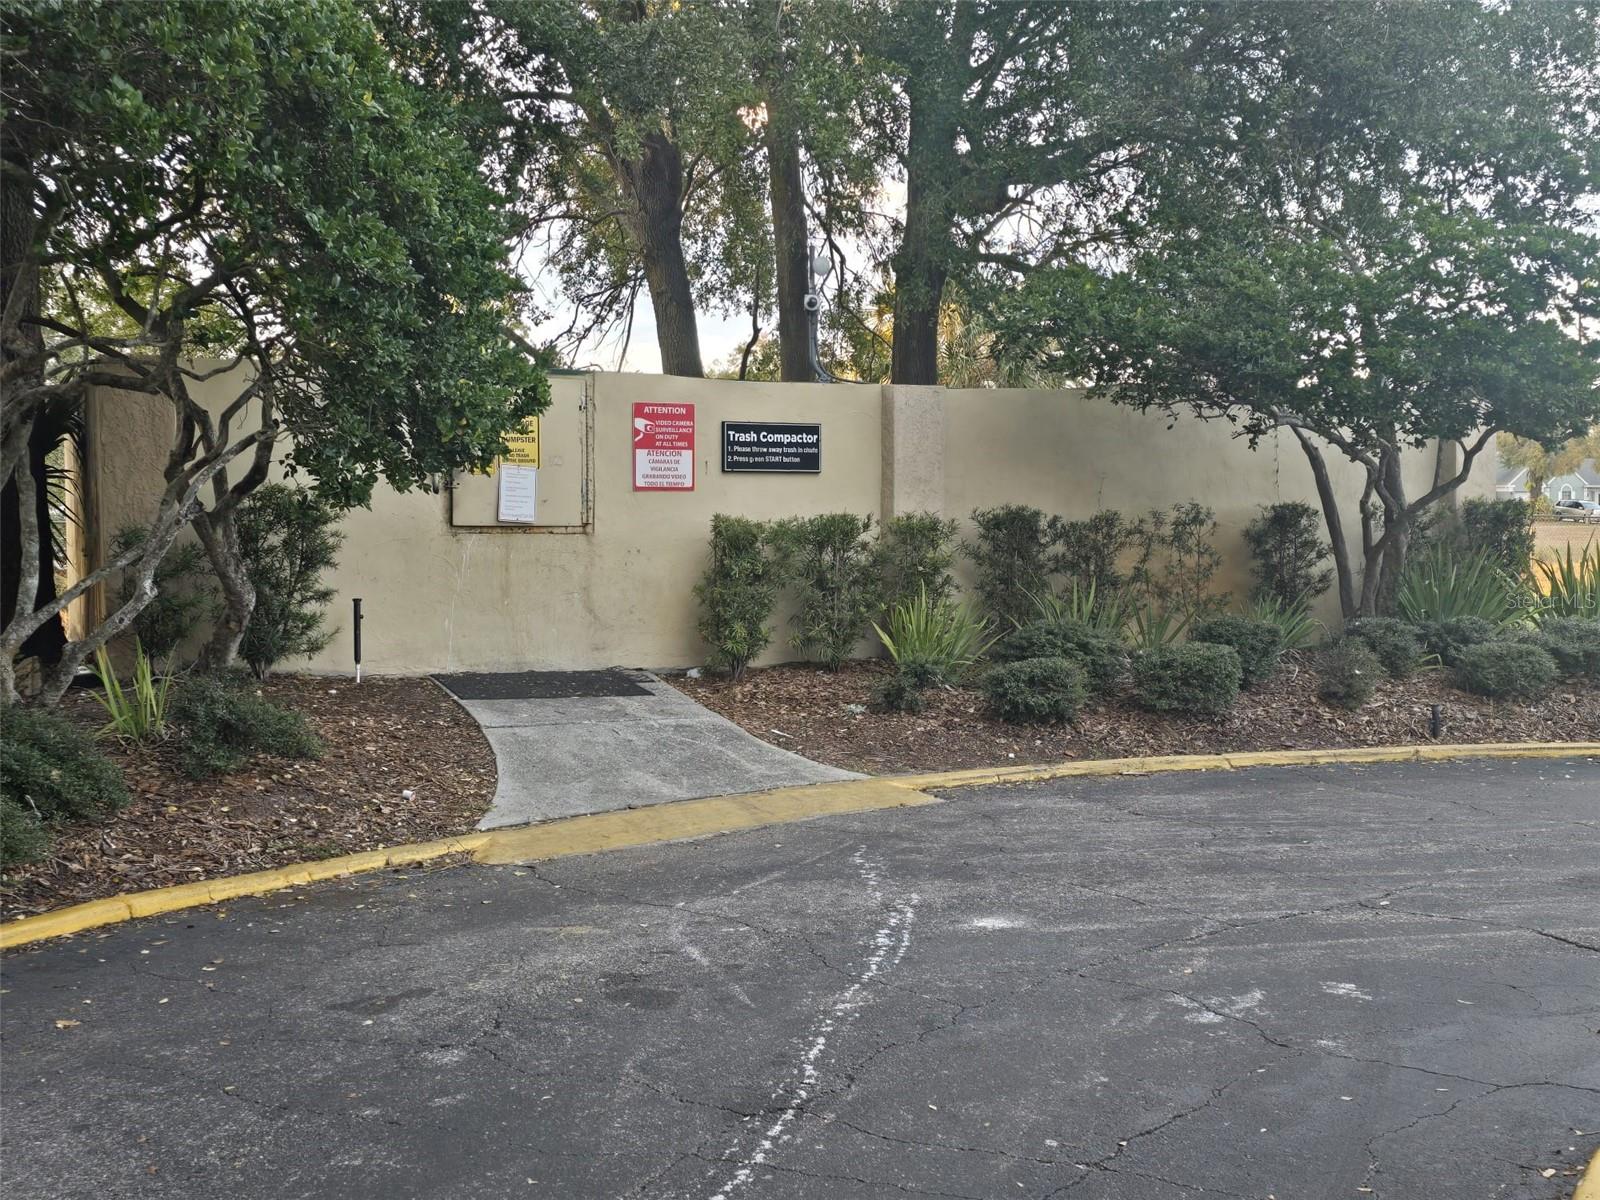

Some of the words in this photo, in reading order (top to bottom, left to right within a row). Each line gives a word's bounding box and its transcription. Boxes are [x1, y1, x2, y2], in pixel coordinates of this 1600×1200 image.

[643, 406, 686, 414] ATTENTION
[728, 430, 758, 442] Trash
[760, 432, 818, 444] Compactor
